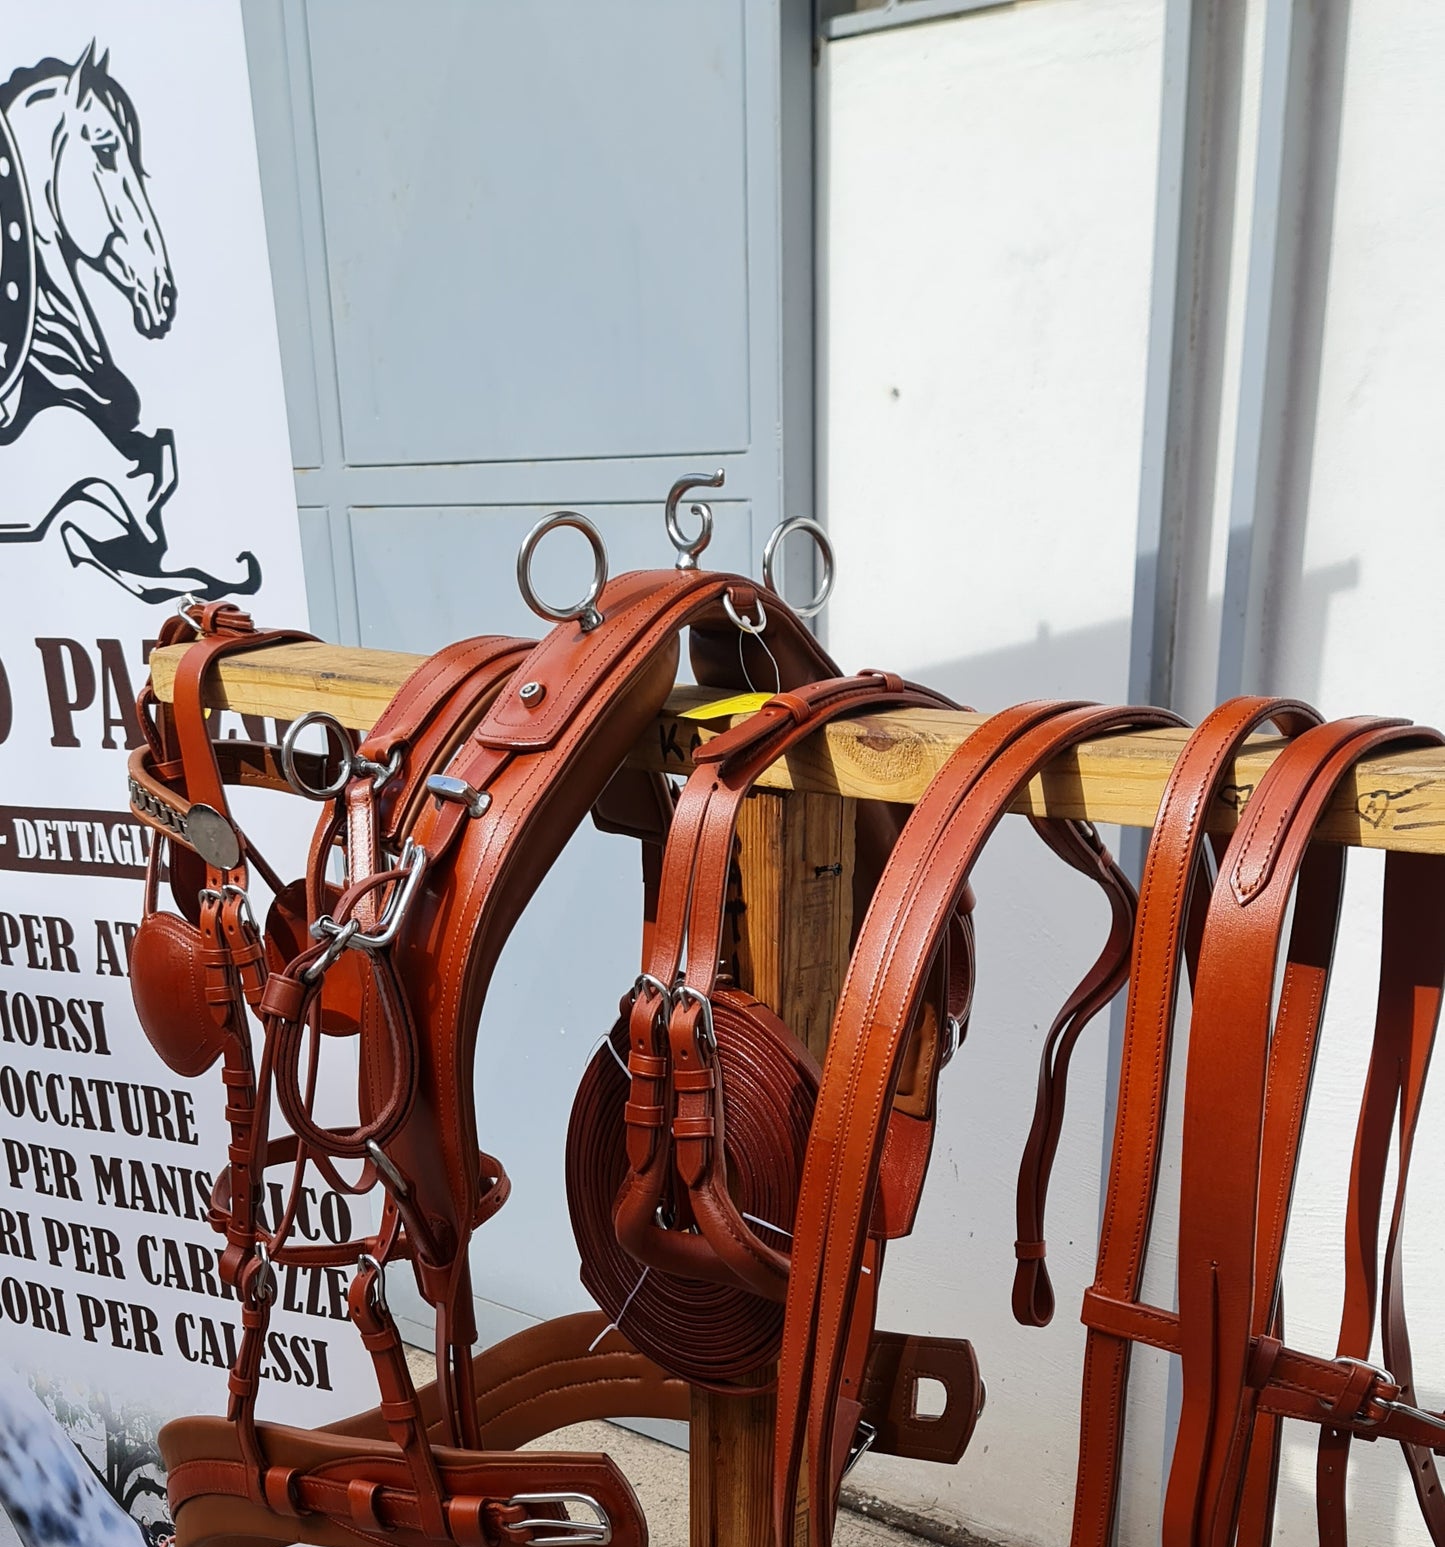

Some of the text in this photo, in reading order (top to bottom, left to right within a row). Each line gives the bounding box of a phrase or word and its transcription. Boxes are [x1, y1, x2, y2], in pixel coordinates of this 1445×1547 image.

[2, 1138, 83, 1201] PER
[41, 1216, 126, 1280] PER
[0, 1276, 71, 1336] ORI
[76, 1293, 163, 1356] PER
